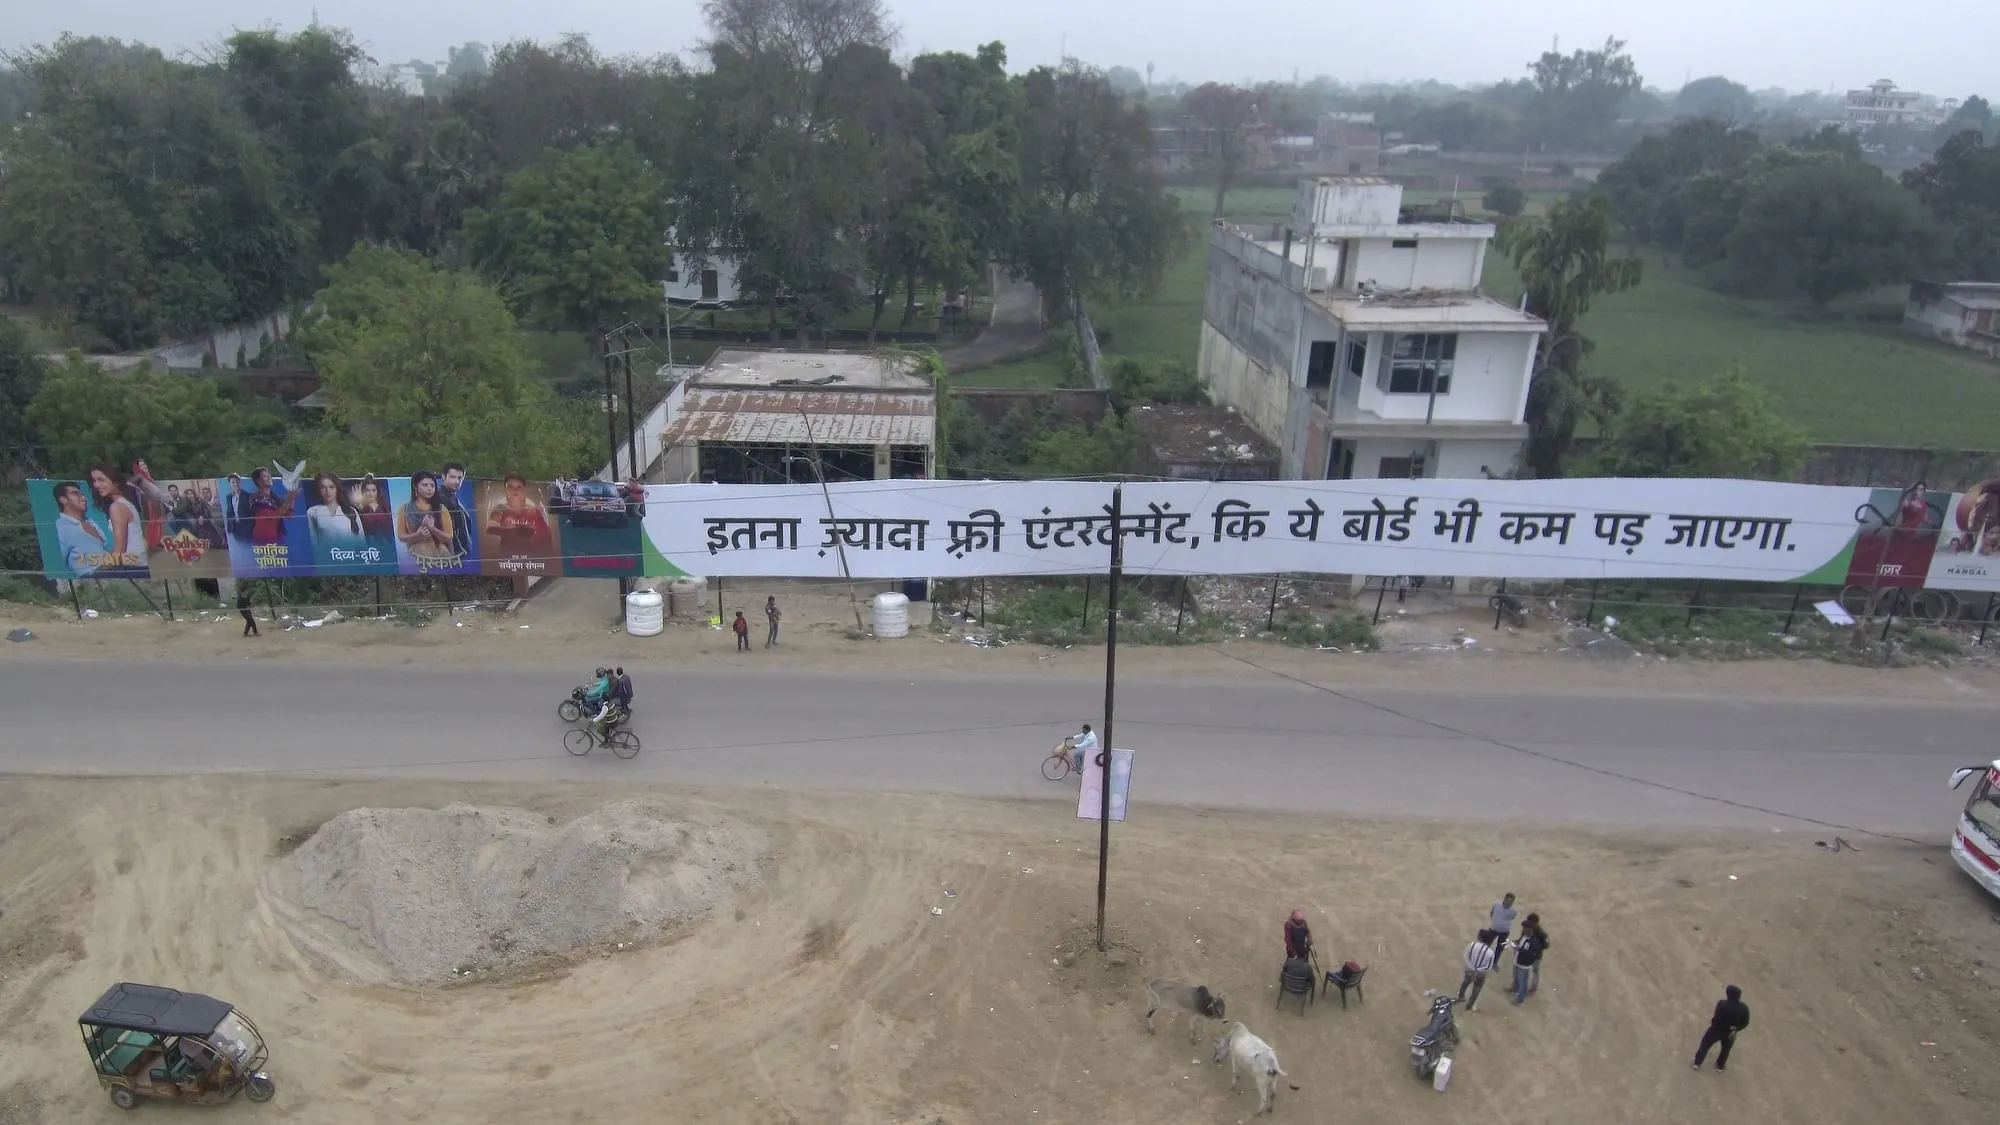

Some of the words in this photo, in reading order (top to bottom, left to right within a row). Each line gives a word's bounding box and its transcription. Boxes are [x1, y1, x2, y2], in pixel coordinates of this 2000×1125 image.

[703, 517, 802, 556] इतना
[819, 518, 930, 558] ज़्यादा
[946, 509, 1005, 560] फ़्री
[1211, 499, 1270, 542] कि
[1288, 498, 1325, 542] ये
[1343, 496, 1419, 542] बोर्ड
[1434, 498, 1482, 543] भी
[1499, 512, 1576, 545] कम
[1594, 513, 1651, 556] पड़
[1665, 514, 1796, 551] जाएगा.
[251, 543, 290, 558] कार्तिक
[330, 547, 381, 565] दिव्य-दृष्टि
[254, 556, 289, 570] पूर्णिमा
